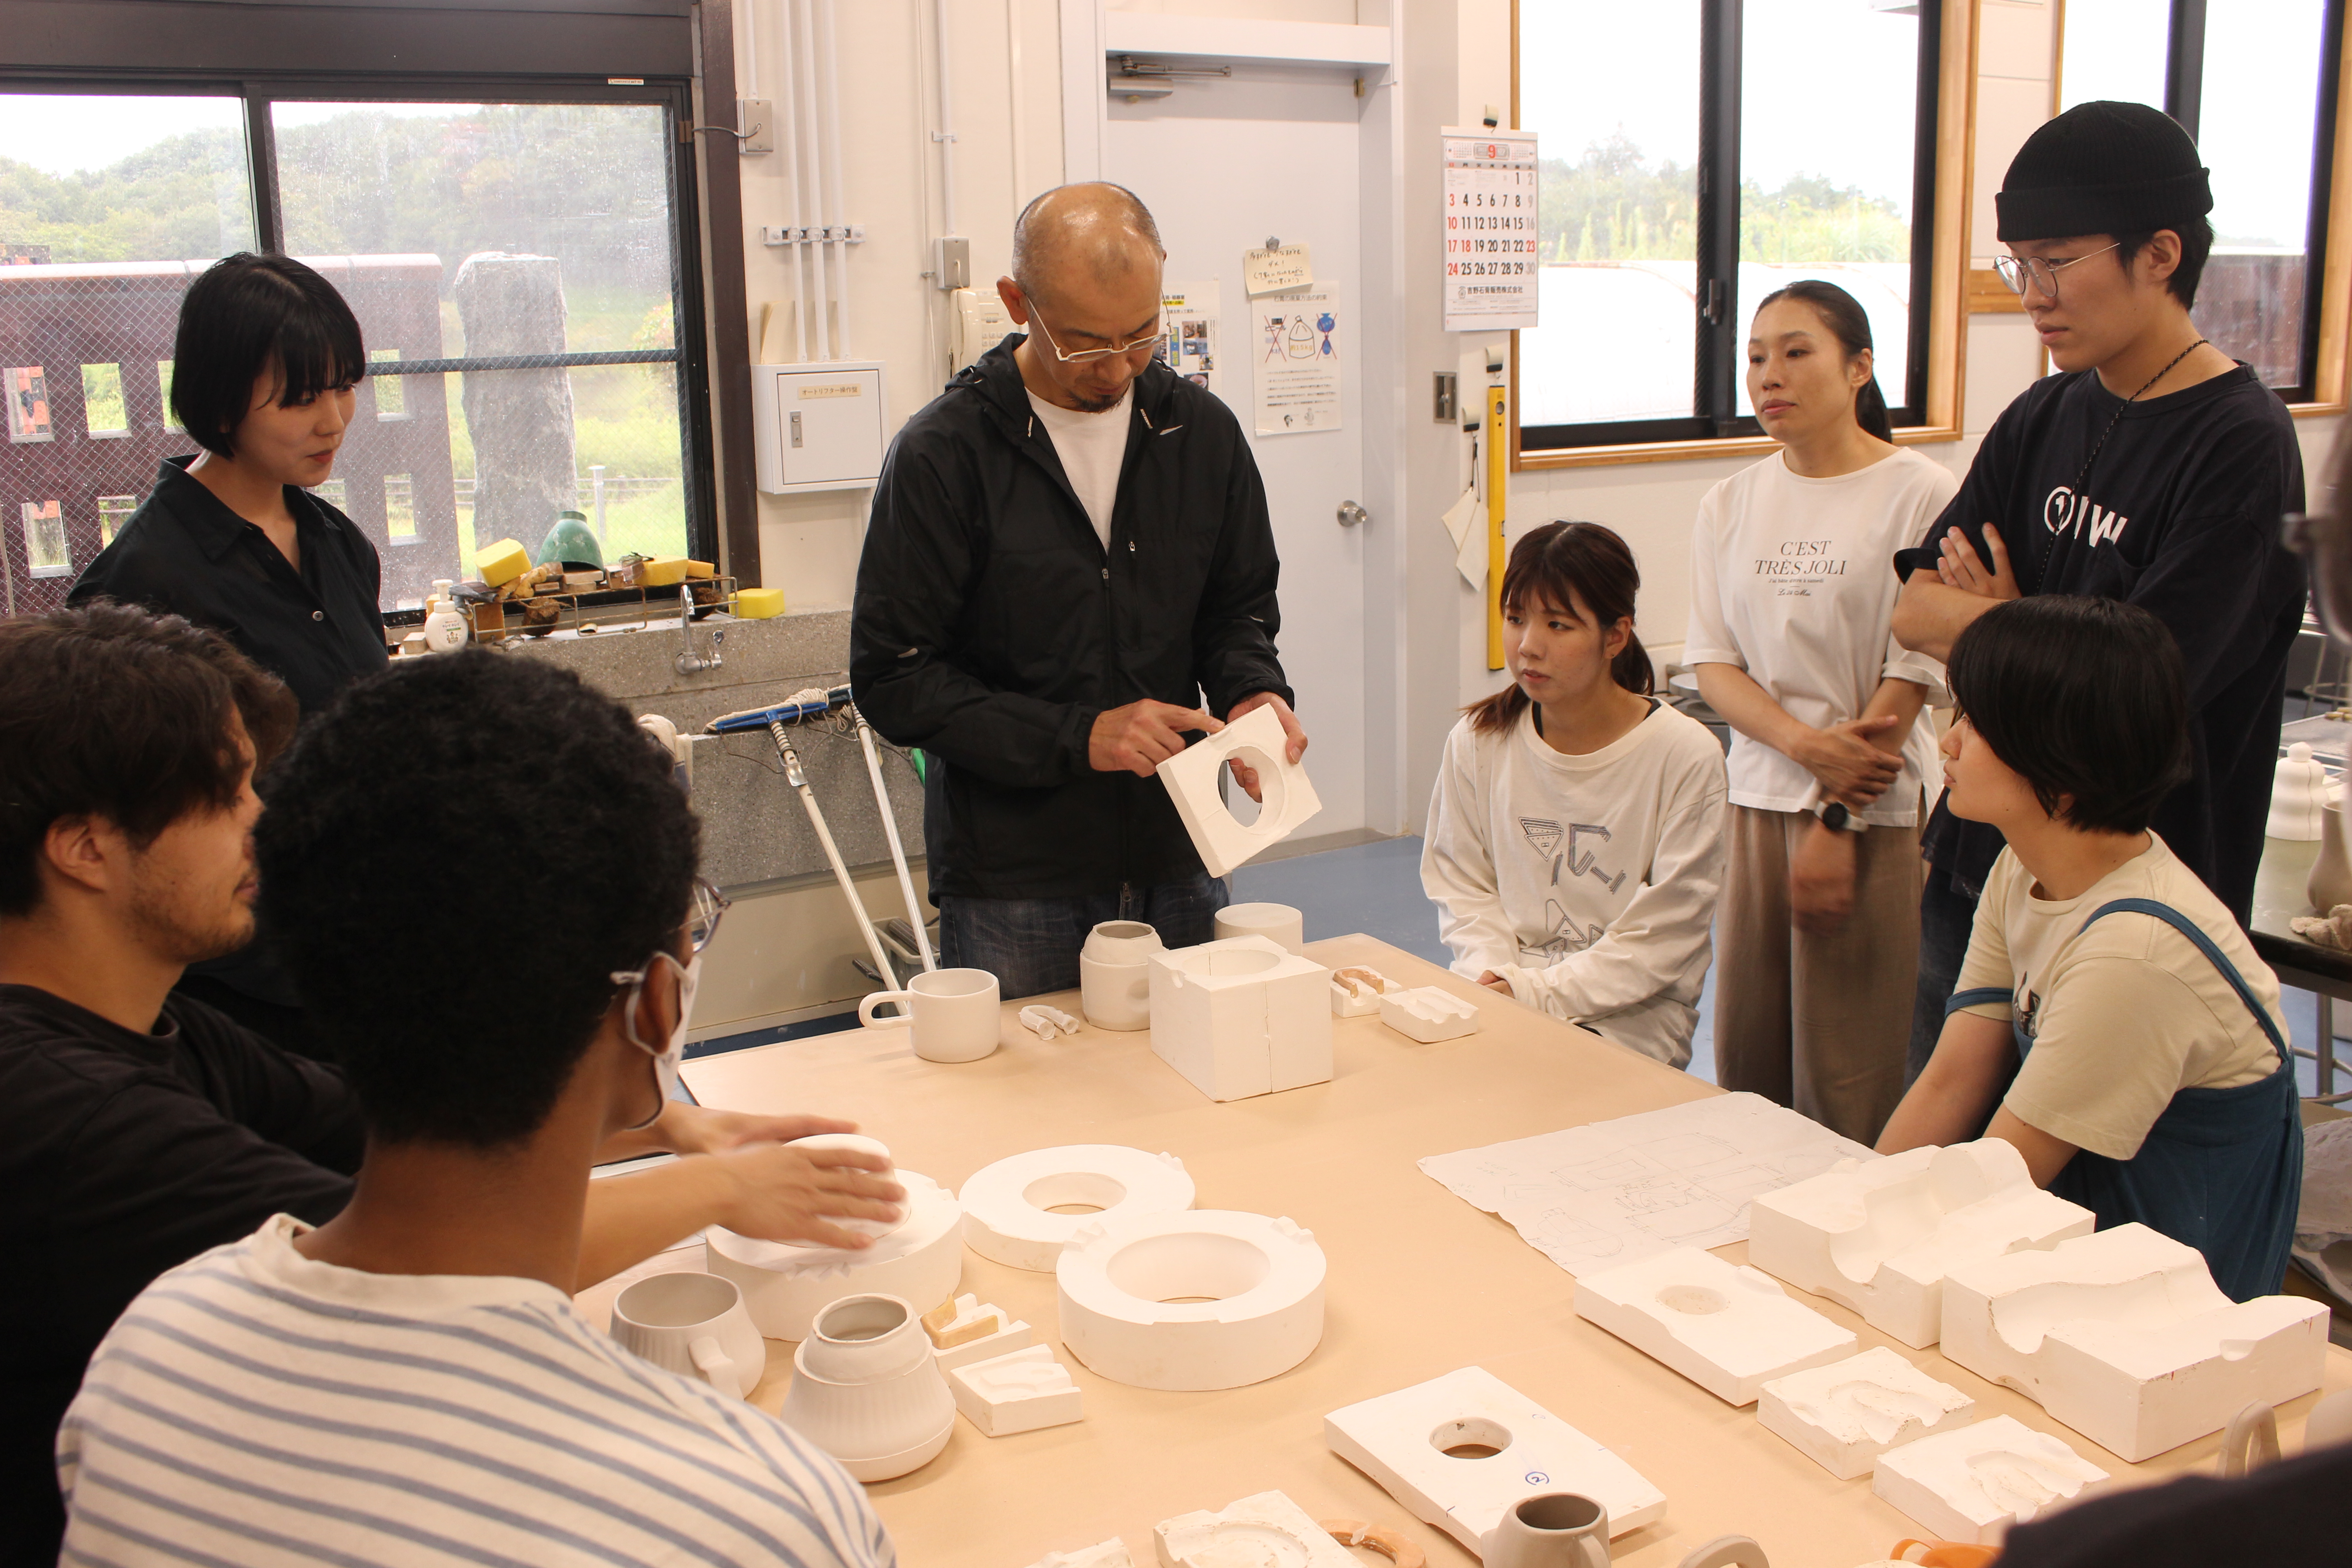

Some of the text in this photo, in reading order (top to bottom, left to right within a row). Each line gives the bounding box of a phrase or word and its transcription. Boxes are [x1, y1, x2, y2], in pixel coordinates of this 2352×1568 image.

[1488, 145, 1495, 158] 9
[1516, 172, 1519, 185] 1
[1528, 172, 1533, 186] 2
[1449, 194, 1534, 208] 3 4 5 6 7 8 9
[1447, 217, 1536, 231] 10 11 12 13 14 15 16
[1448, 240, 1535, 253] 17 18 19 20 21 22 23
[1447, 262, 1536, 276] 24 25 26 27 28 29 30
[1467, 285, 1523, 294] 吉野石膏販売株式会社
[802, 387, 858, 395] オートリフター操作盤
[1780, 540, 1832, 556] C'EST
[1754, 559, 1847, 575] TRÈS JOLI
